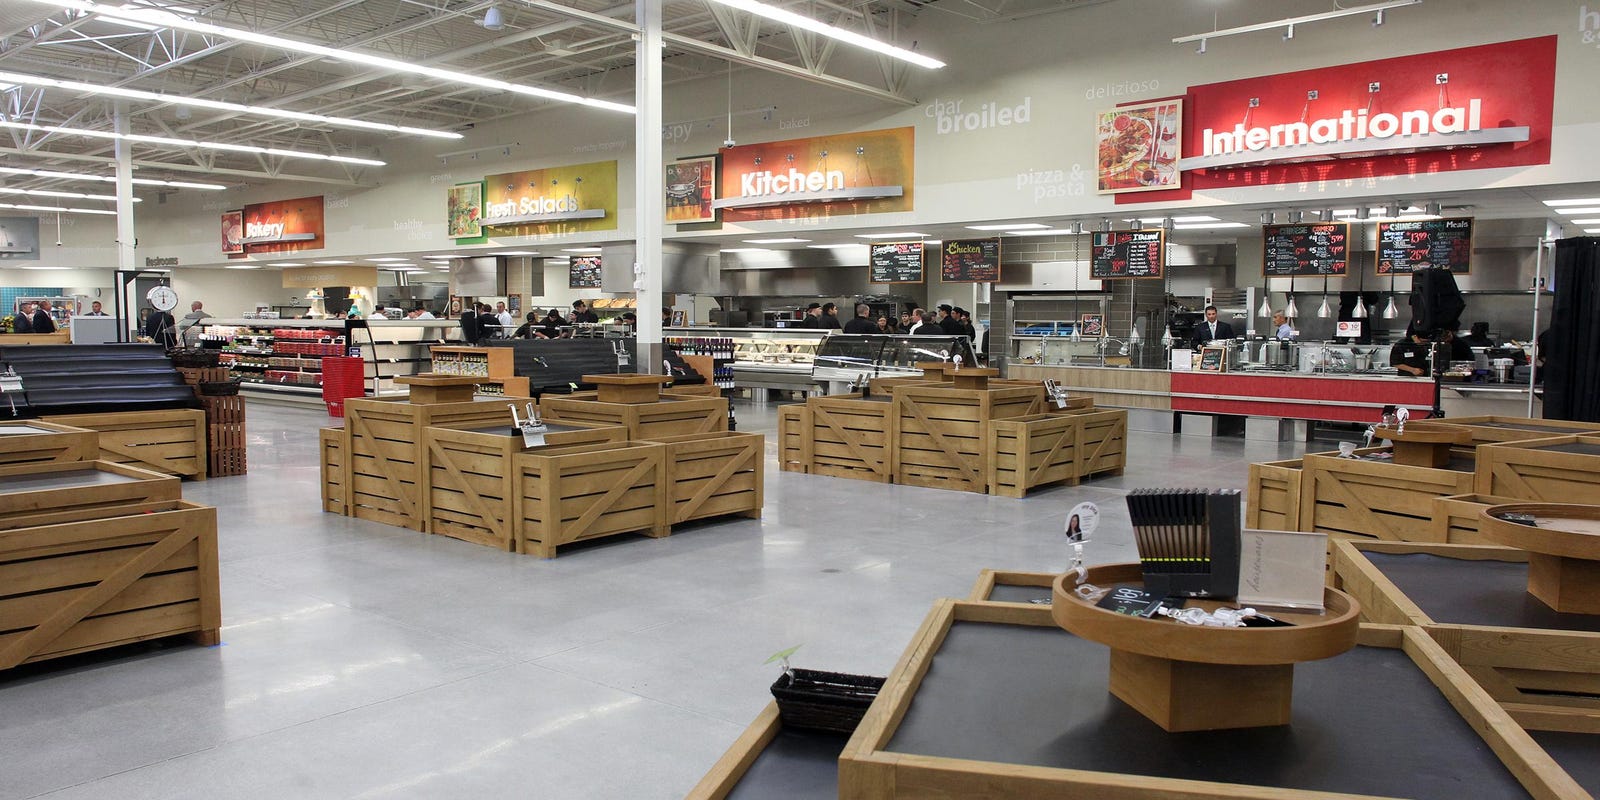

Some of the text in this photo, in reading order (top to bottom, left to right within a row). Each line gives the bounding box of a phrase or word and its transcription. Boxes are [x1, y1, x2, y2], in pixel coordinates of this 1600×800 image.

[1086, 79, 1159, 100] delizioso
[925, 98, 963, 119] char
[937, 97, 1031, 134] broiled
[662, 123, 693, 143] spy
[779, 117, 810, 130] baked
[1203, 98, 1482, 157] International
[741, 168, 845, 198] Kitchen
[1016, 168, 1064, 190] pizza
[1034, 181, 1084, 203] pasta
[486, 194, 578, 218] Fresh Salads
[39, 217, 75, 227] heathy
[246, 221, 285, 239] Bakery
[945, 241, 981, 255] Chicken
